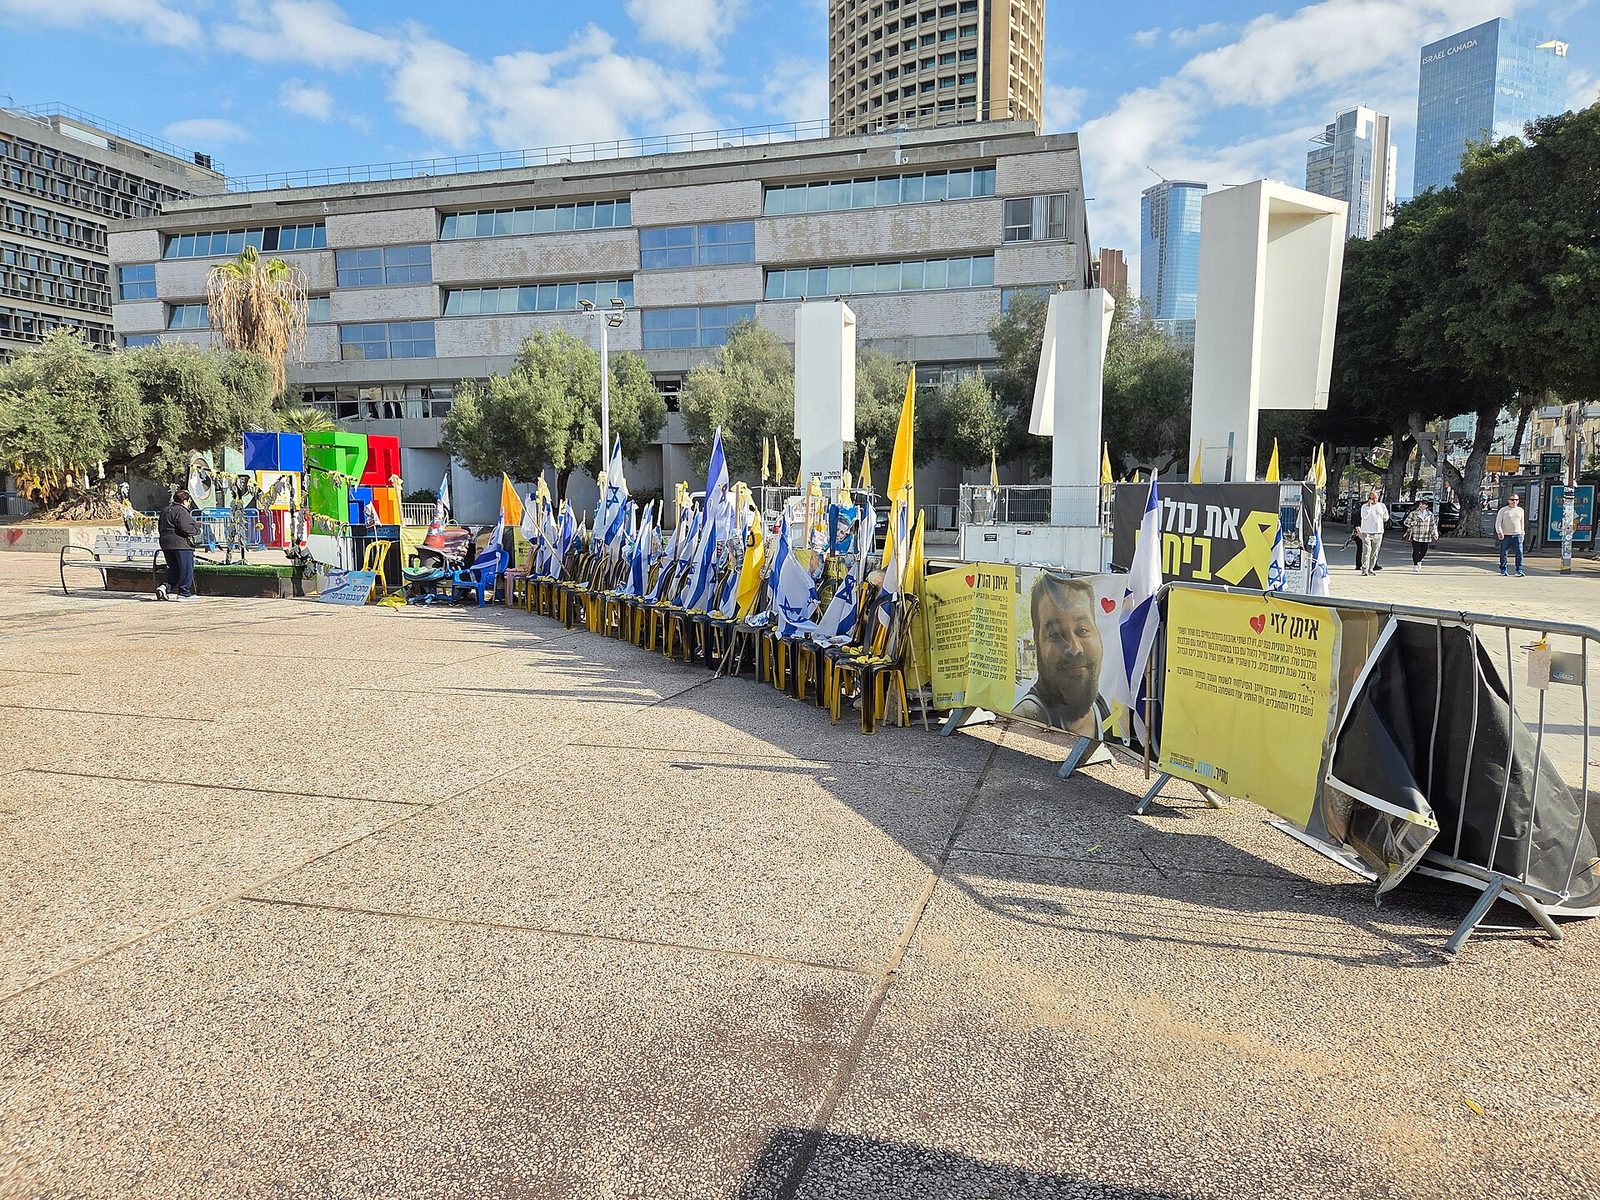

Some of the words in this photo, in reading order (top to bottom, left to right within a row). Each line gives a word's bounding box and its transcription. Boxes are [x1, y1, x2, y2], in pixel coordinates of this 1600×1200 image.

[1422, 50, 1446, 64] ISRAEL
[1447, 40, 1477, 55] CANADA
[1556, 40, 1569, 56] EY
[1158, 497, 1199, 534] כול
[1204, 505, 1240, 540] את
[1135, 530, 1212, 581] ביח
[993, 575, 1008, 590] איתן
[1290, 617, 1320, 640] איתן
